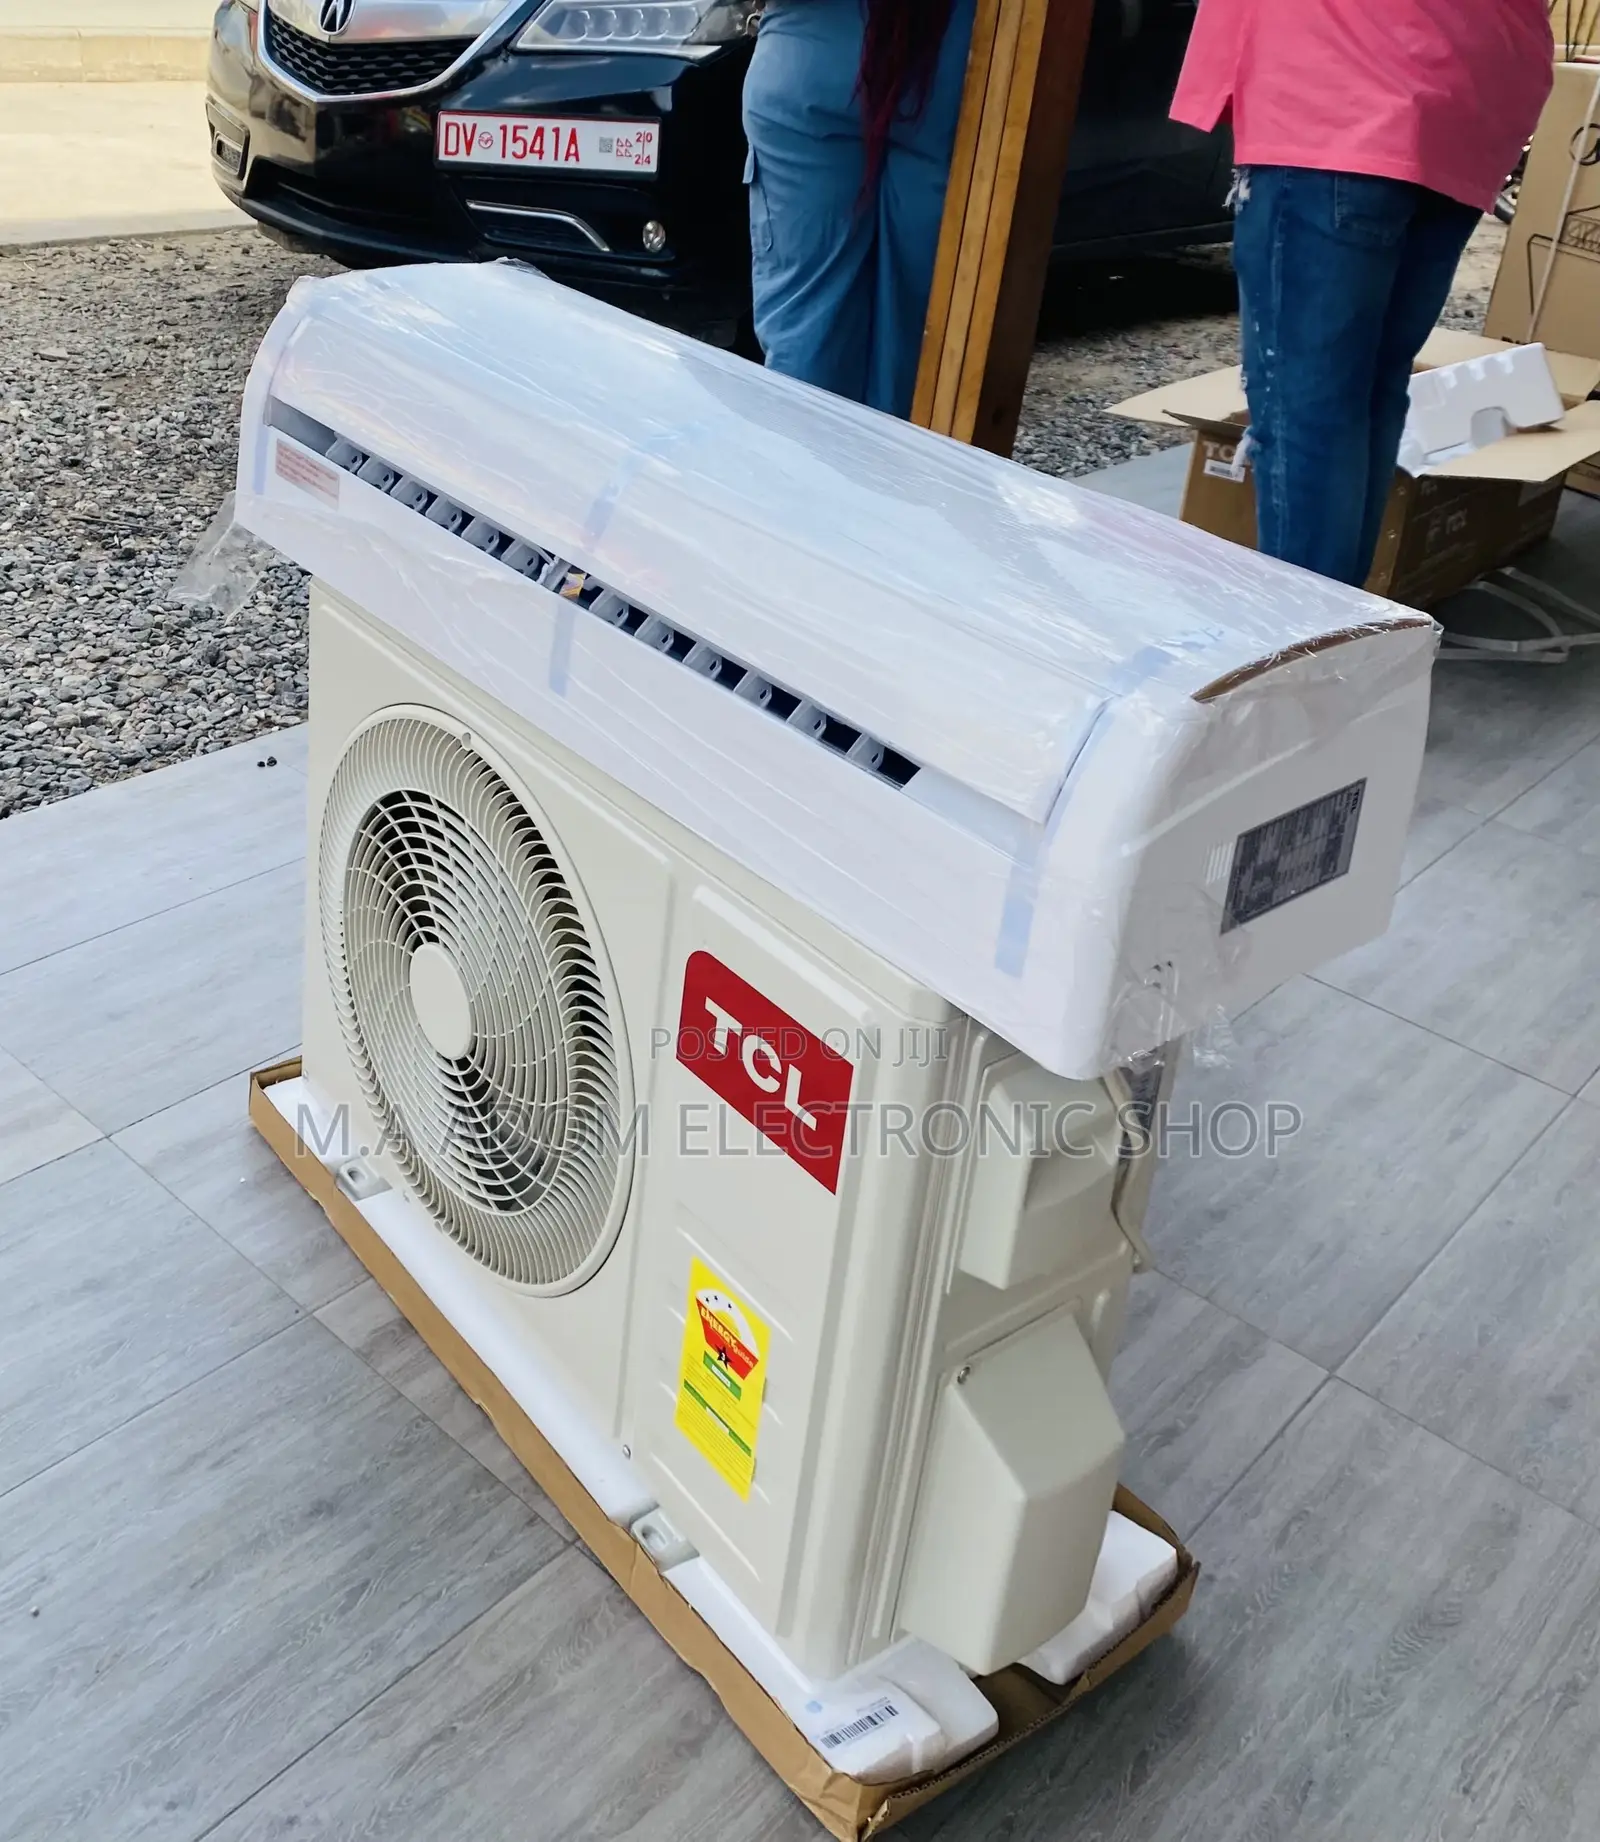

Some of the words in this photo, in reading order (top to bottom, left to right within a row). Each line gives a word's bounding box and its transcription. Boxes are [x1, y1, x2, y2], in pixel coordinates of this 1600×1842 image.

[444, 122, 477, 156] DV
[499, 124, 580, 162] 1541A
[704, 996, 817, 1131] TCL
[700, 1307, 738, 1348] ENERGY
